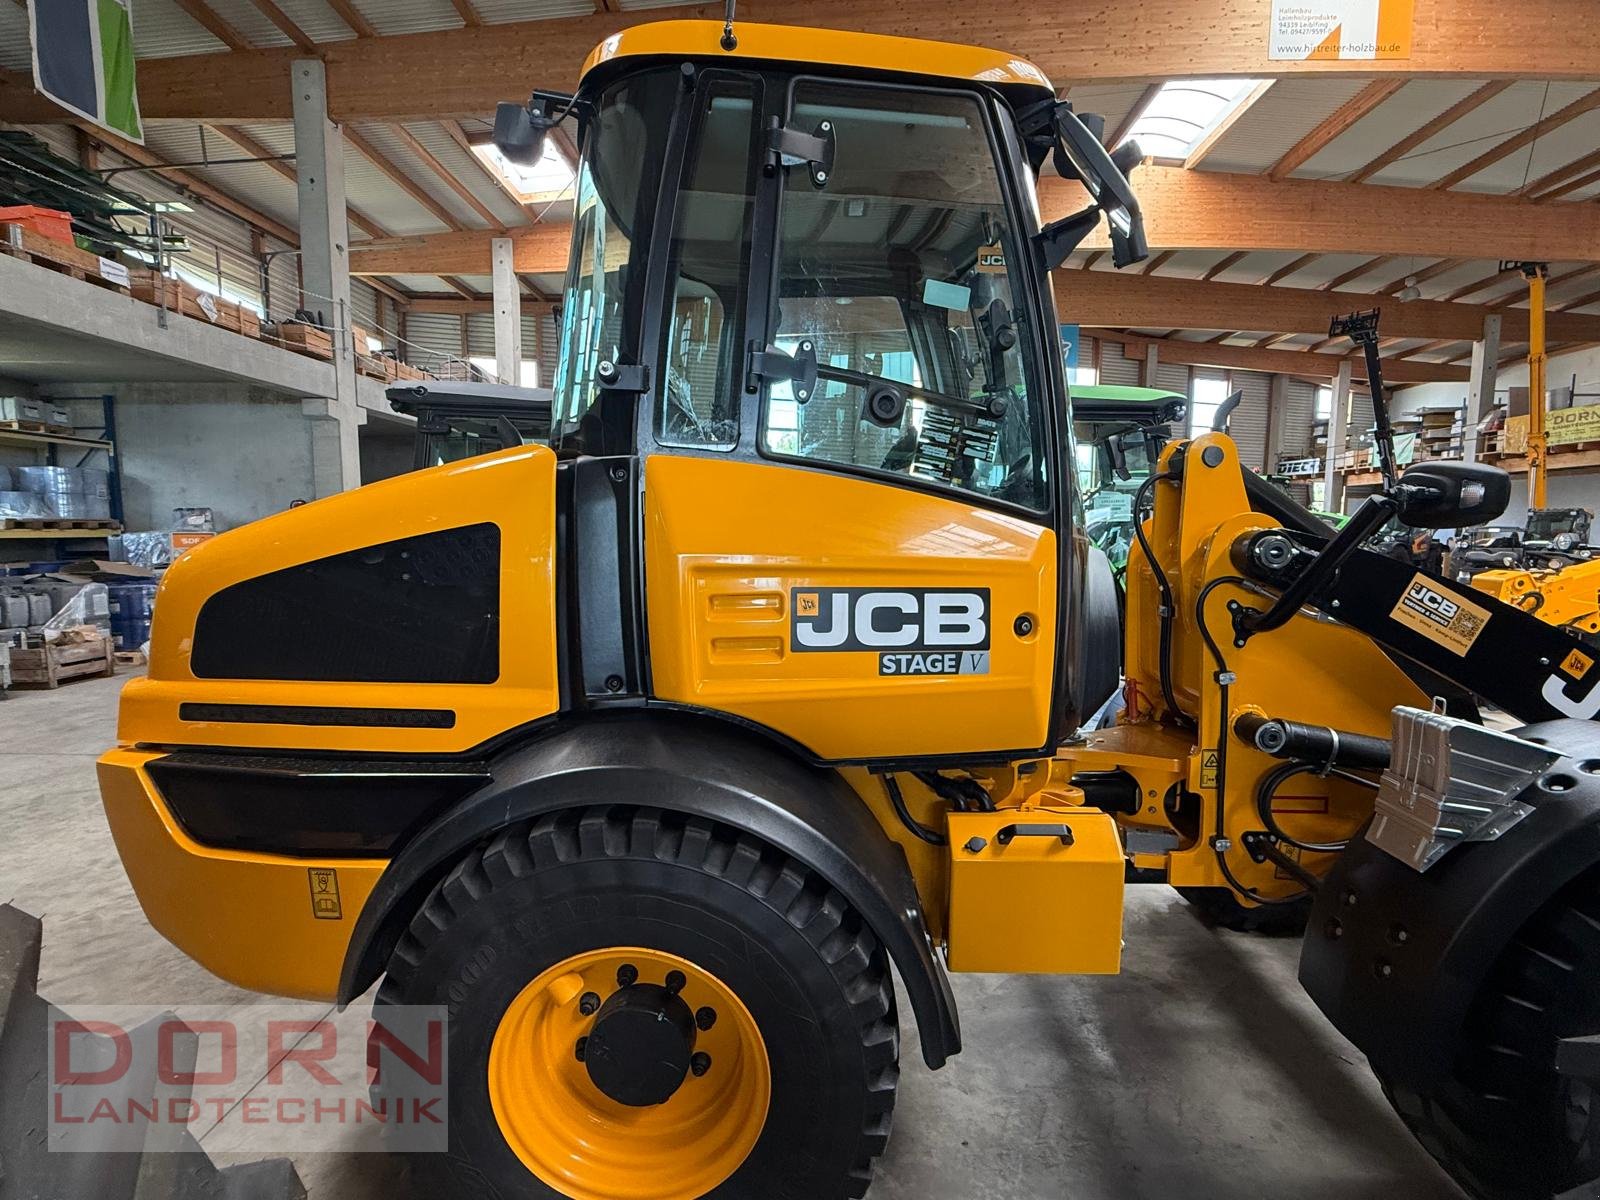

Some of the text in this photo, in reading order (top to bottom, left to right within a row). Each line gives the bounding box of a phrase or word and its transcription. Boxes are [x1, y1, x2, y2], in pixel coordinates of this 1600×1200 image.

[1277, 43, 1401, 53] www.hirtreiter-holzbau.de
[981, 256, 1006, 266] JC
[1409, 587, 1458, 618] JCB
[797, 592, 986, 647] JCB
[882, 653, 984, 674] STAGE V
